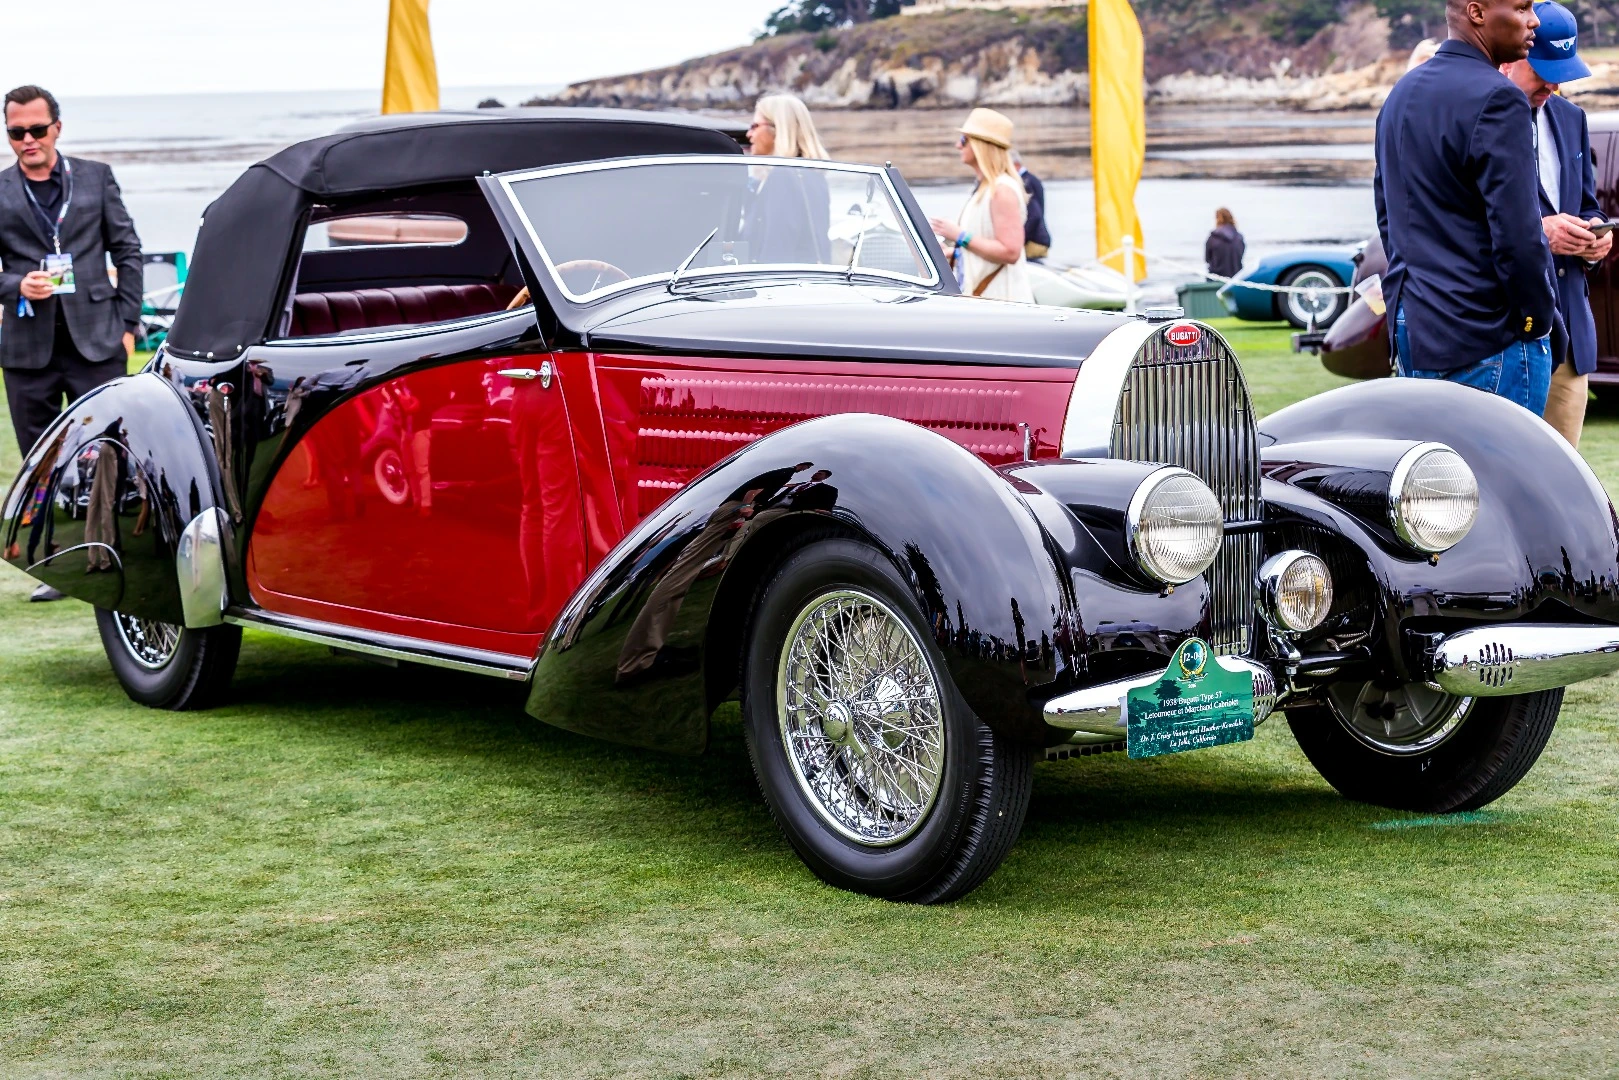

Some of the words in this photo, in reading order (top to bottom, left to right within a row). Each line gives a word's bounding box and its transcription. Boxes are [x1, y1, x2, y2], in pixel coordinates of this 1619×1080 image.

[1171, 331, 1198, 340] BUGATTI
[1163, 698, 1177, 707] 1938
[1178, 694, 1200, 705] Bugatti
[1200, 693, 1215, 703] Type
[1215, 690, 1223, 699] 57
[1184, 702, 1213, 714] Marchand
[1213, 698, 1239, 709] Cabriolet
[1189, 726, 1200, 735] and
[1169, 739, 1177, 748] La
[1192, 734, 1217, 744] California
